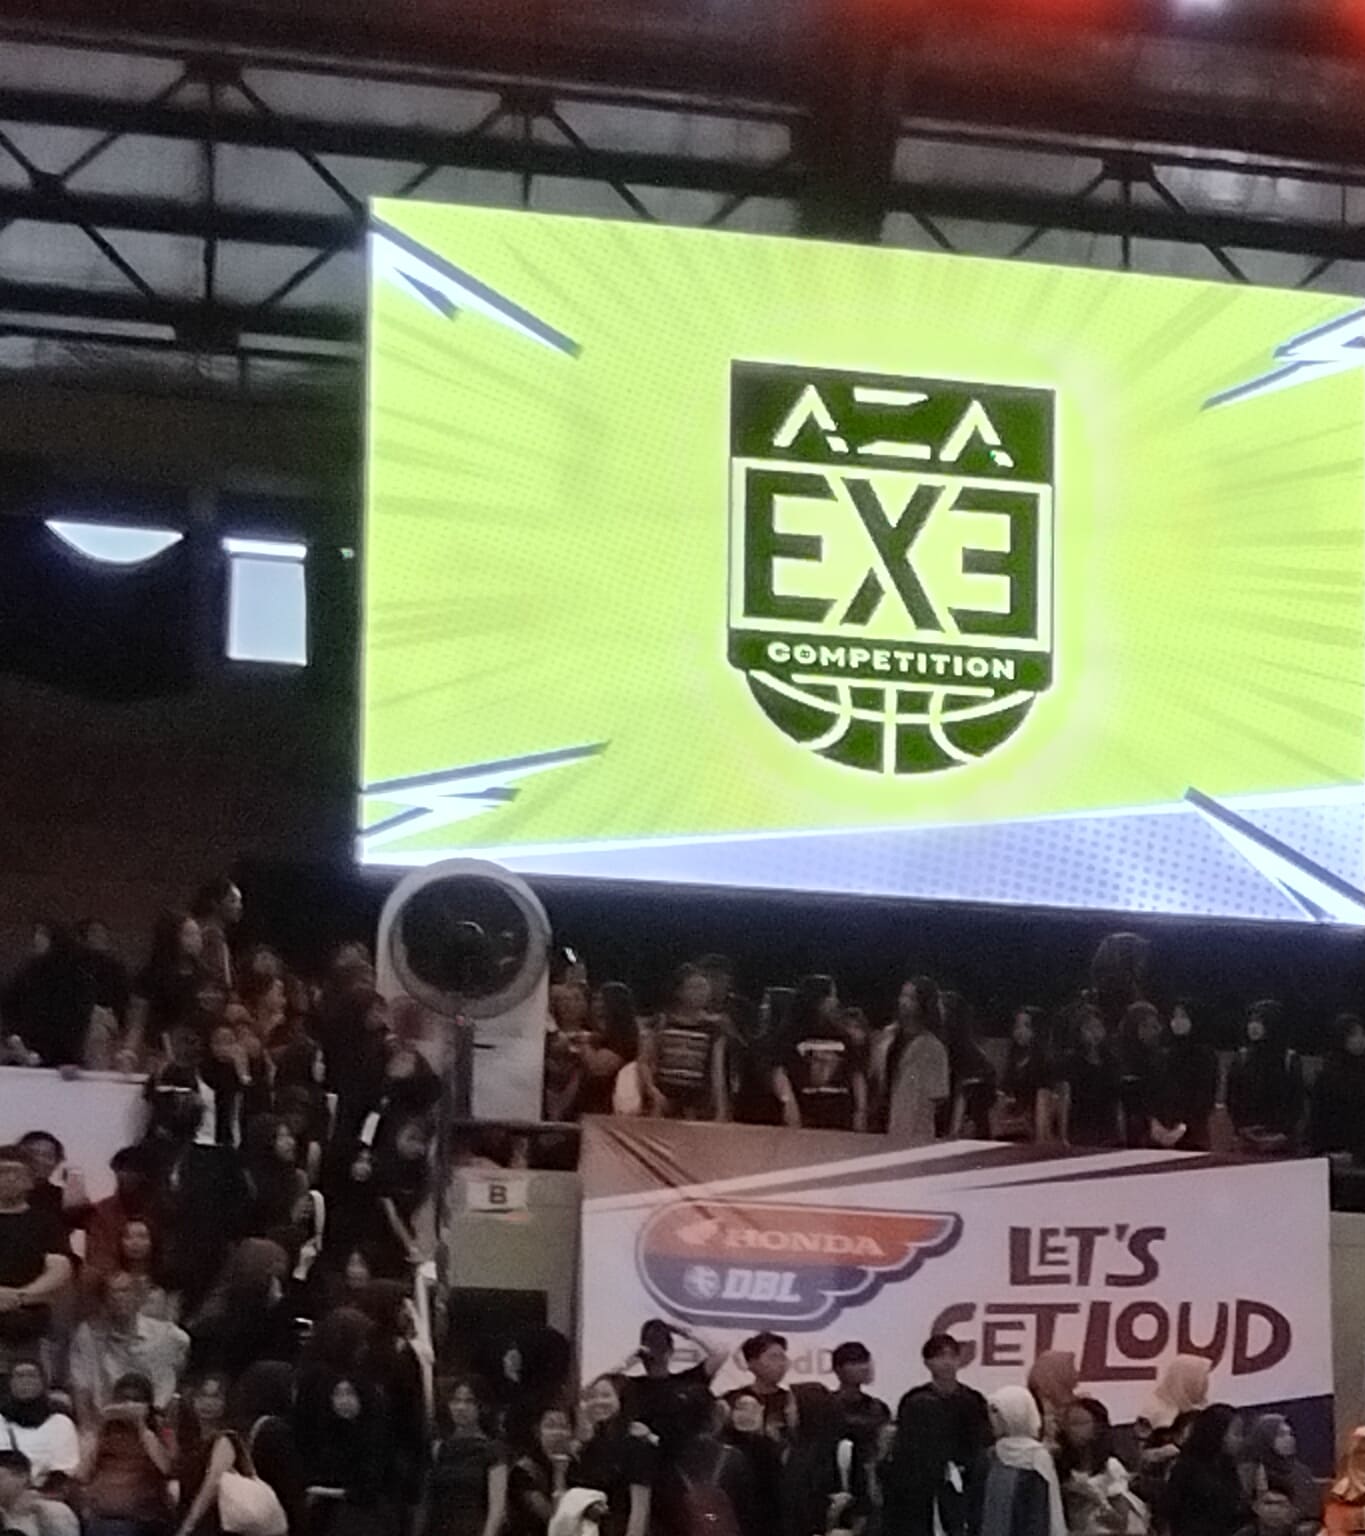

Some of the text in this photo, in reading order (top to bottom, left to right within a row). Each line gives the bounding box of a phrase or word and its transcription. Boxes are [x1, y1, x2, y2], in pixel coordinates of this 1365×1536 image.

[766, 640, 1017, 681] COMPETITION
[722, 1228, 886, 1257] HONDA
[1009, 1223, 1167, 1288] LET'S
[720, 1267, 801, 1302] DBL
